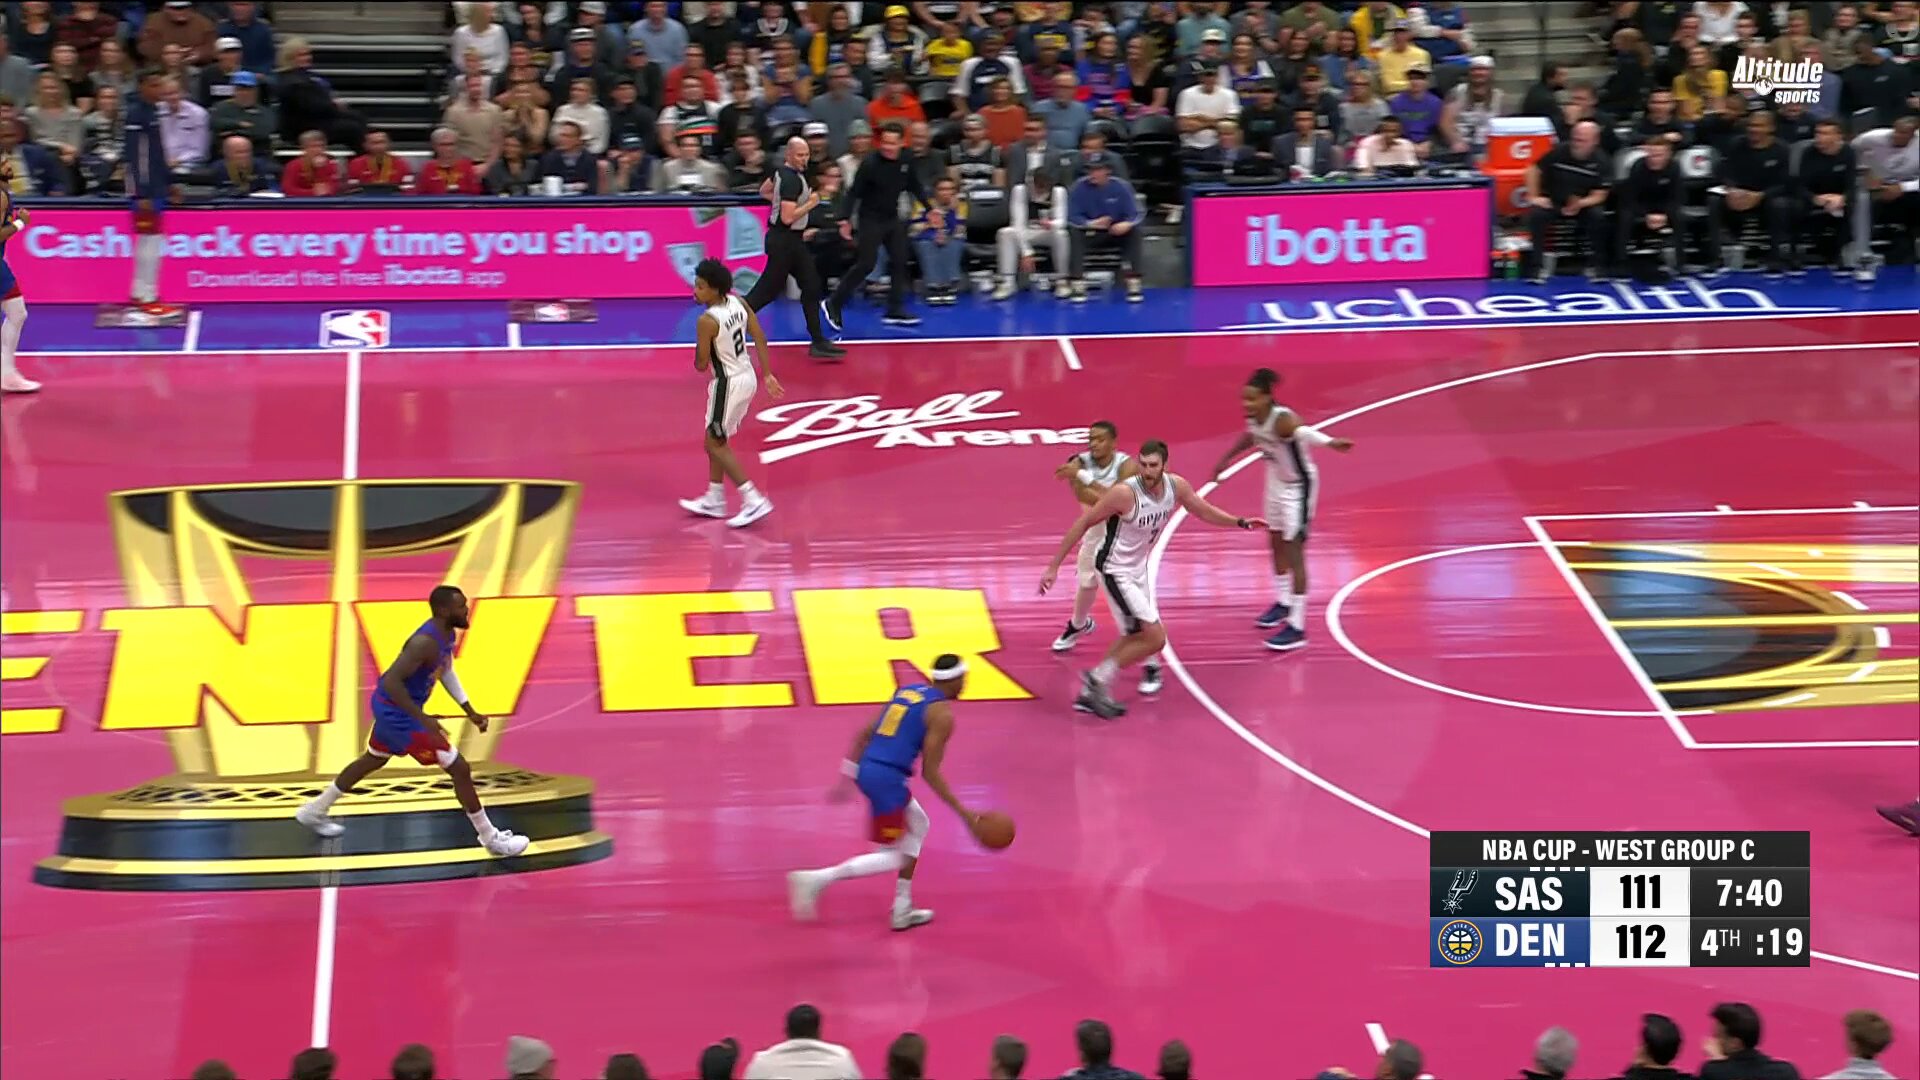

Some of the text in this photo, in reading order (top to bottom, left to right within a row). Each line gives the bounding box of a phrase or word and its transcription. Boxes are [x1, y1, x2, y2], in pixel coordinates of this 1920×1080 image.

[1510, 140, 1532, 160] G
[24, 223, 653, 265] Cash ack every time you shop
[1245, 213, 1429, 266] ibotta
[187, 263, 506, 289] Download the free ibotta app
[1262, 277, 1780, 324] uchealth
[732, 327, 745, 357] 2
[756, 390, 1020, 447] Ball
